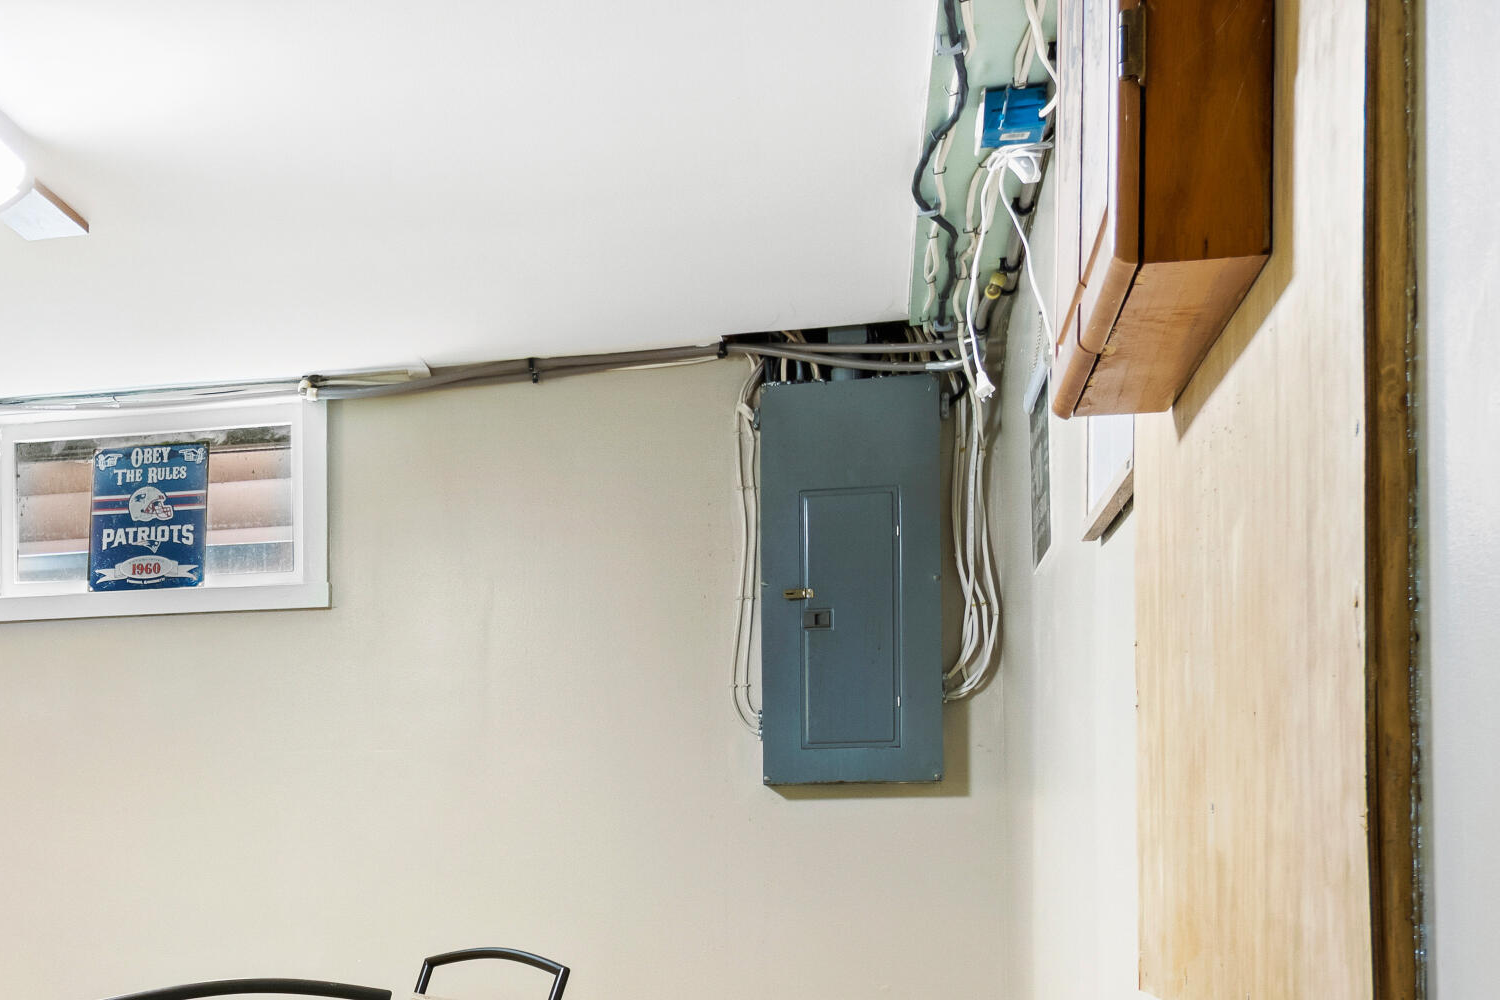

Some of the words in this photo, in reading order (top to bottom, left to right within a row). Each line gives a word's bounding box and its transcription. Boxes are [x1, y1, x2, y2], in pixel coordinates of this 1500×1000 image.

[131, 447, 171, 468] OBEY
[113, 469, 143, 486] THE
[147, 466, 187, 484] RULES
[102, 524, 195, 551] PATRIOTS
[132, 562, 161, 575] 1960
